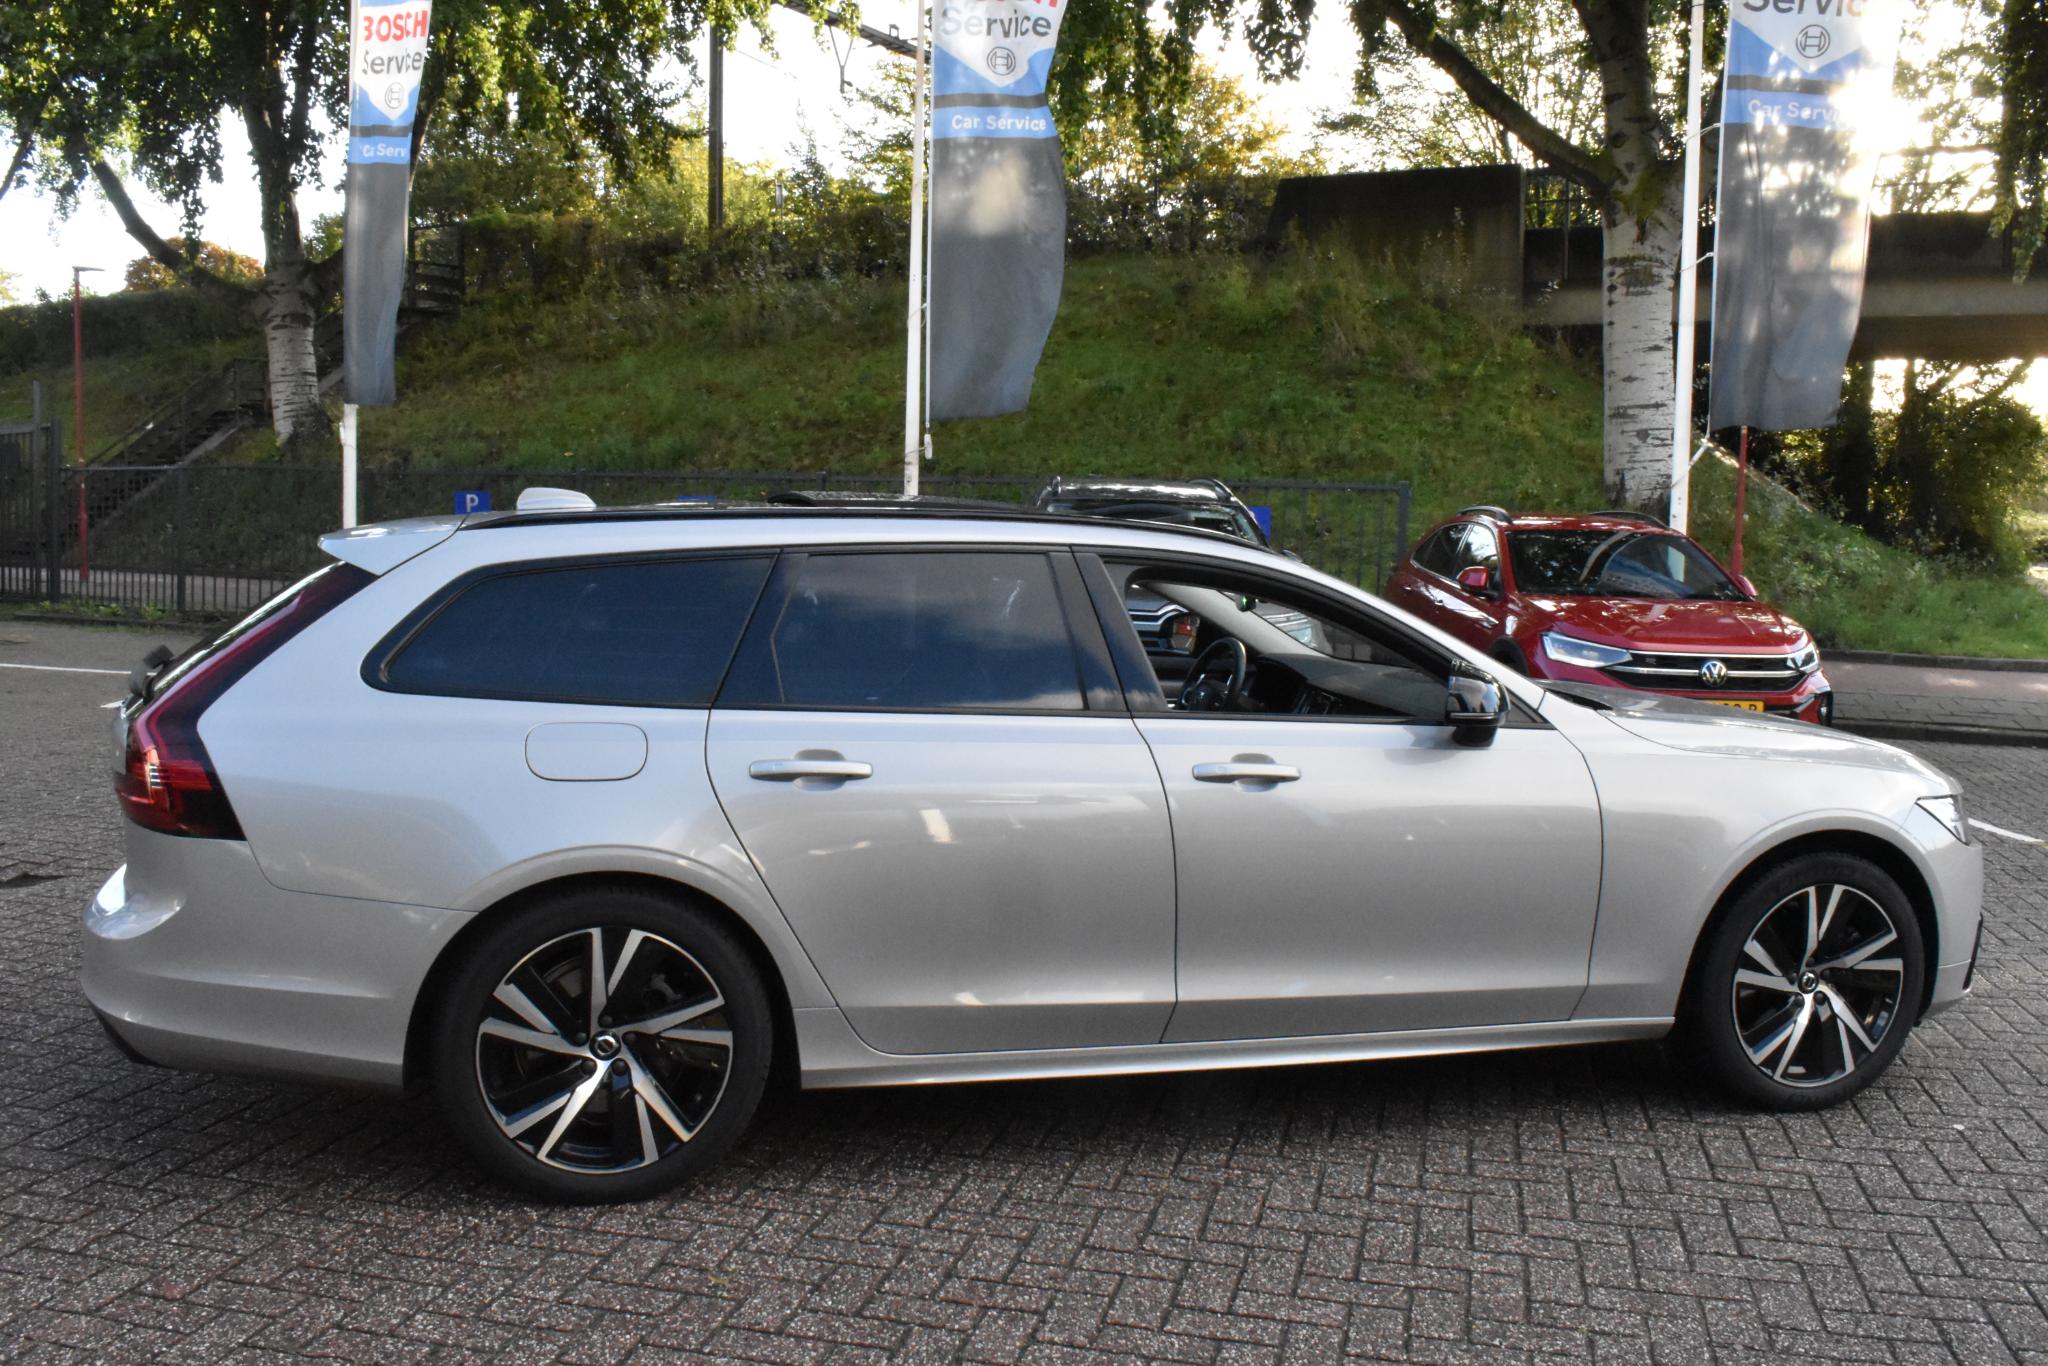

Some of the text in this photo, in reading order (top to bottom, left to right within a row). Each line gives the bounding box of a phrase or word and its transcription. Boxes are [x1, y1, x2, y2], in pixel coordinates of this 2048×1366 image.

[941, 7, 1052, 38] Service
[951, 115, 1047, 131] Car Service
[466, 494, 479, 513] P
